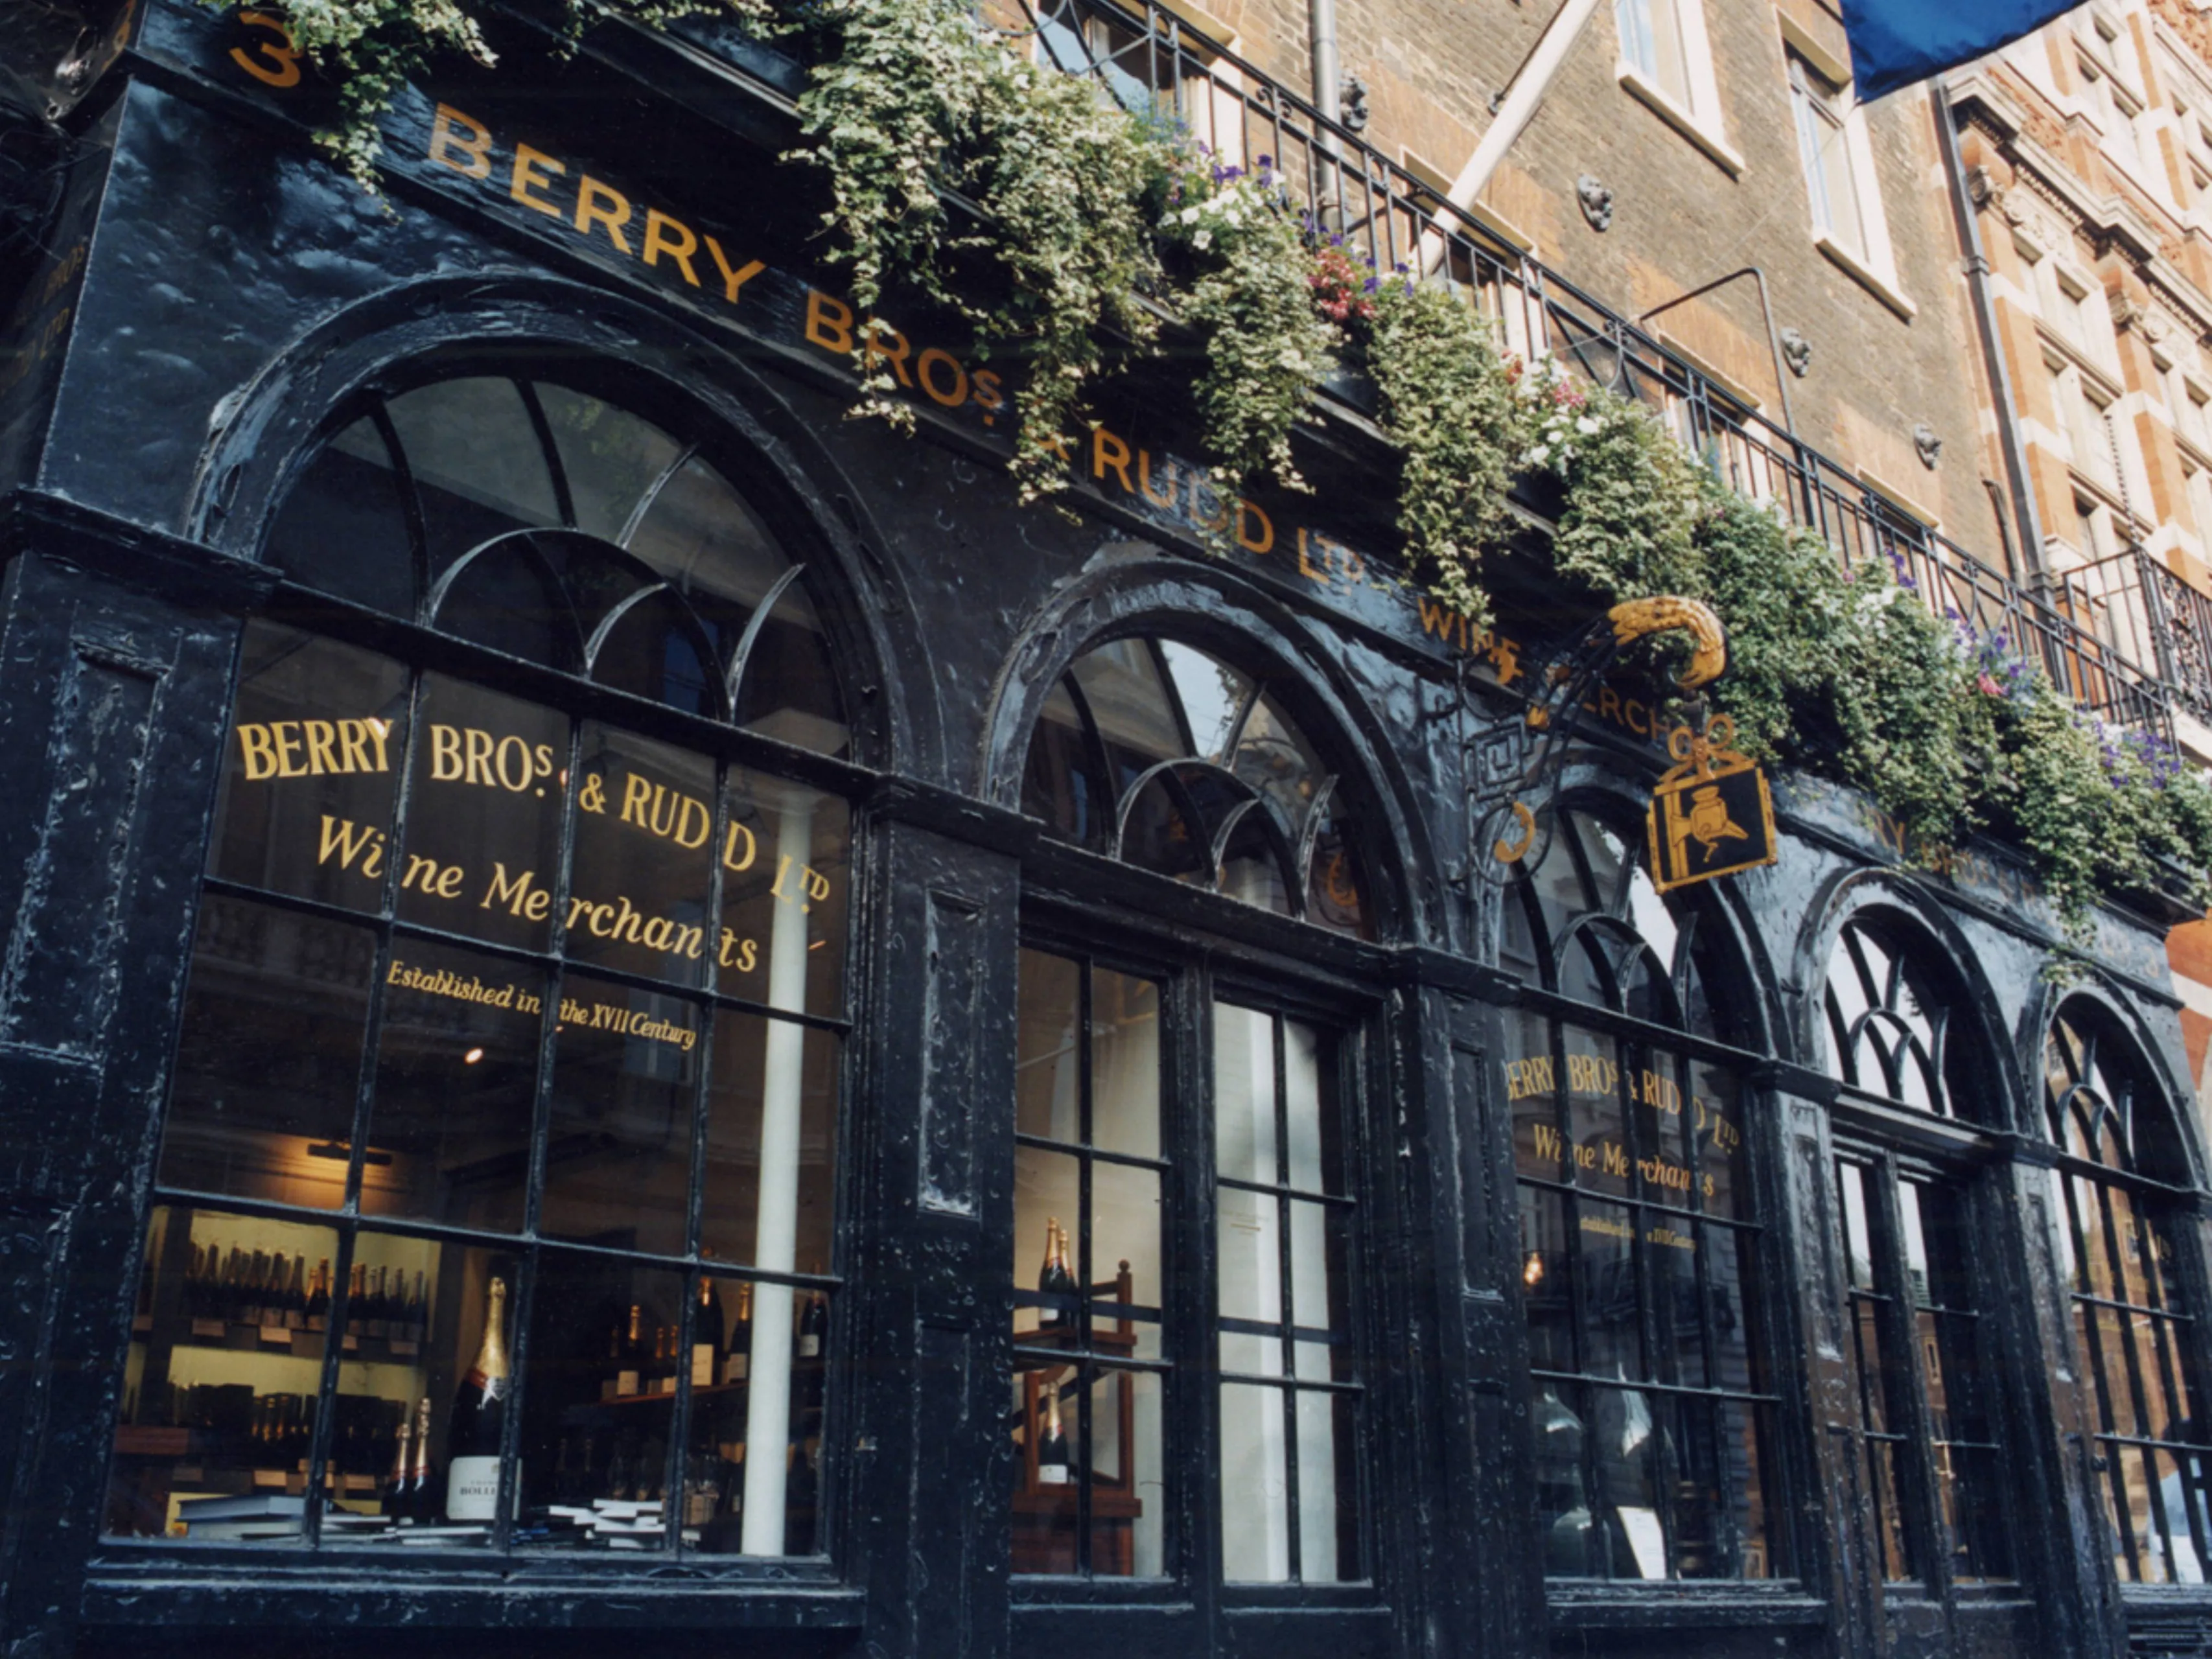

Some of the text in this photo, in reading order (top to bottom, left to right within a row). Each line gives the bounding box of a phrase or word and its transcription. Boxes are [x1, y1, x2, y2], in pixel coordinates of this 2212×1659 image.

[229, 10, 303, 88] 3
[427, 102, 765, 304] BERRY
[1093, 426, 1274, 554] RUDD
[238, 717, 394, 780] BERRY
[579, 773, 607, 815] &
[621, 771, 757, 872] RUDD
[317, 815, 758, 973] Wine Merchants
[387, 960, 697, 1050] Established in the XVII Century
[1642, 1069, 1706, 1130] RUDD
[1533, 1123, 1714, 1197] Wine Merchans
